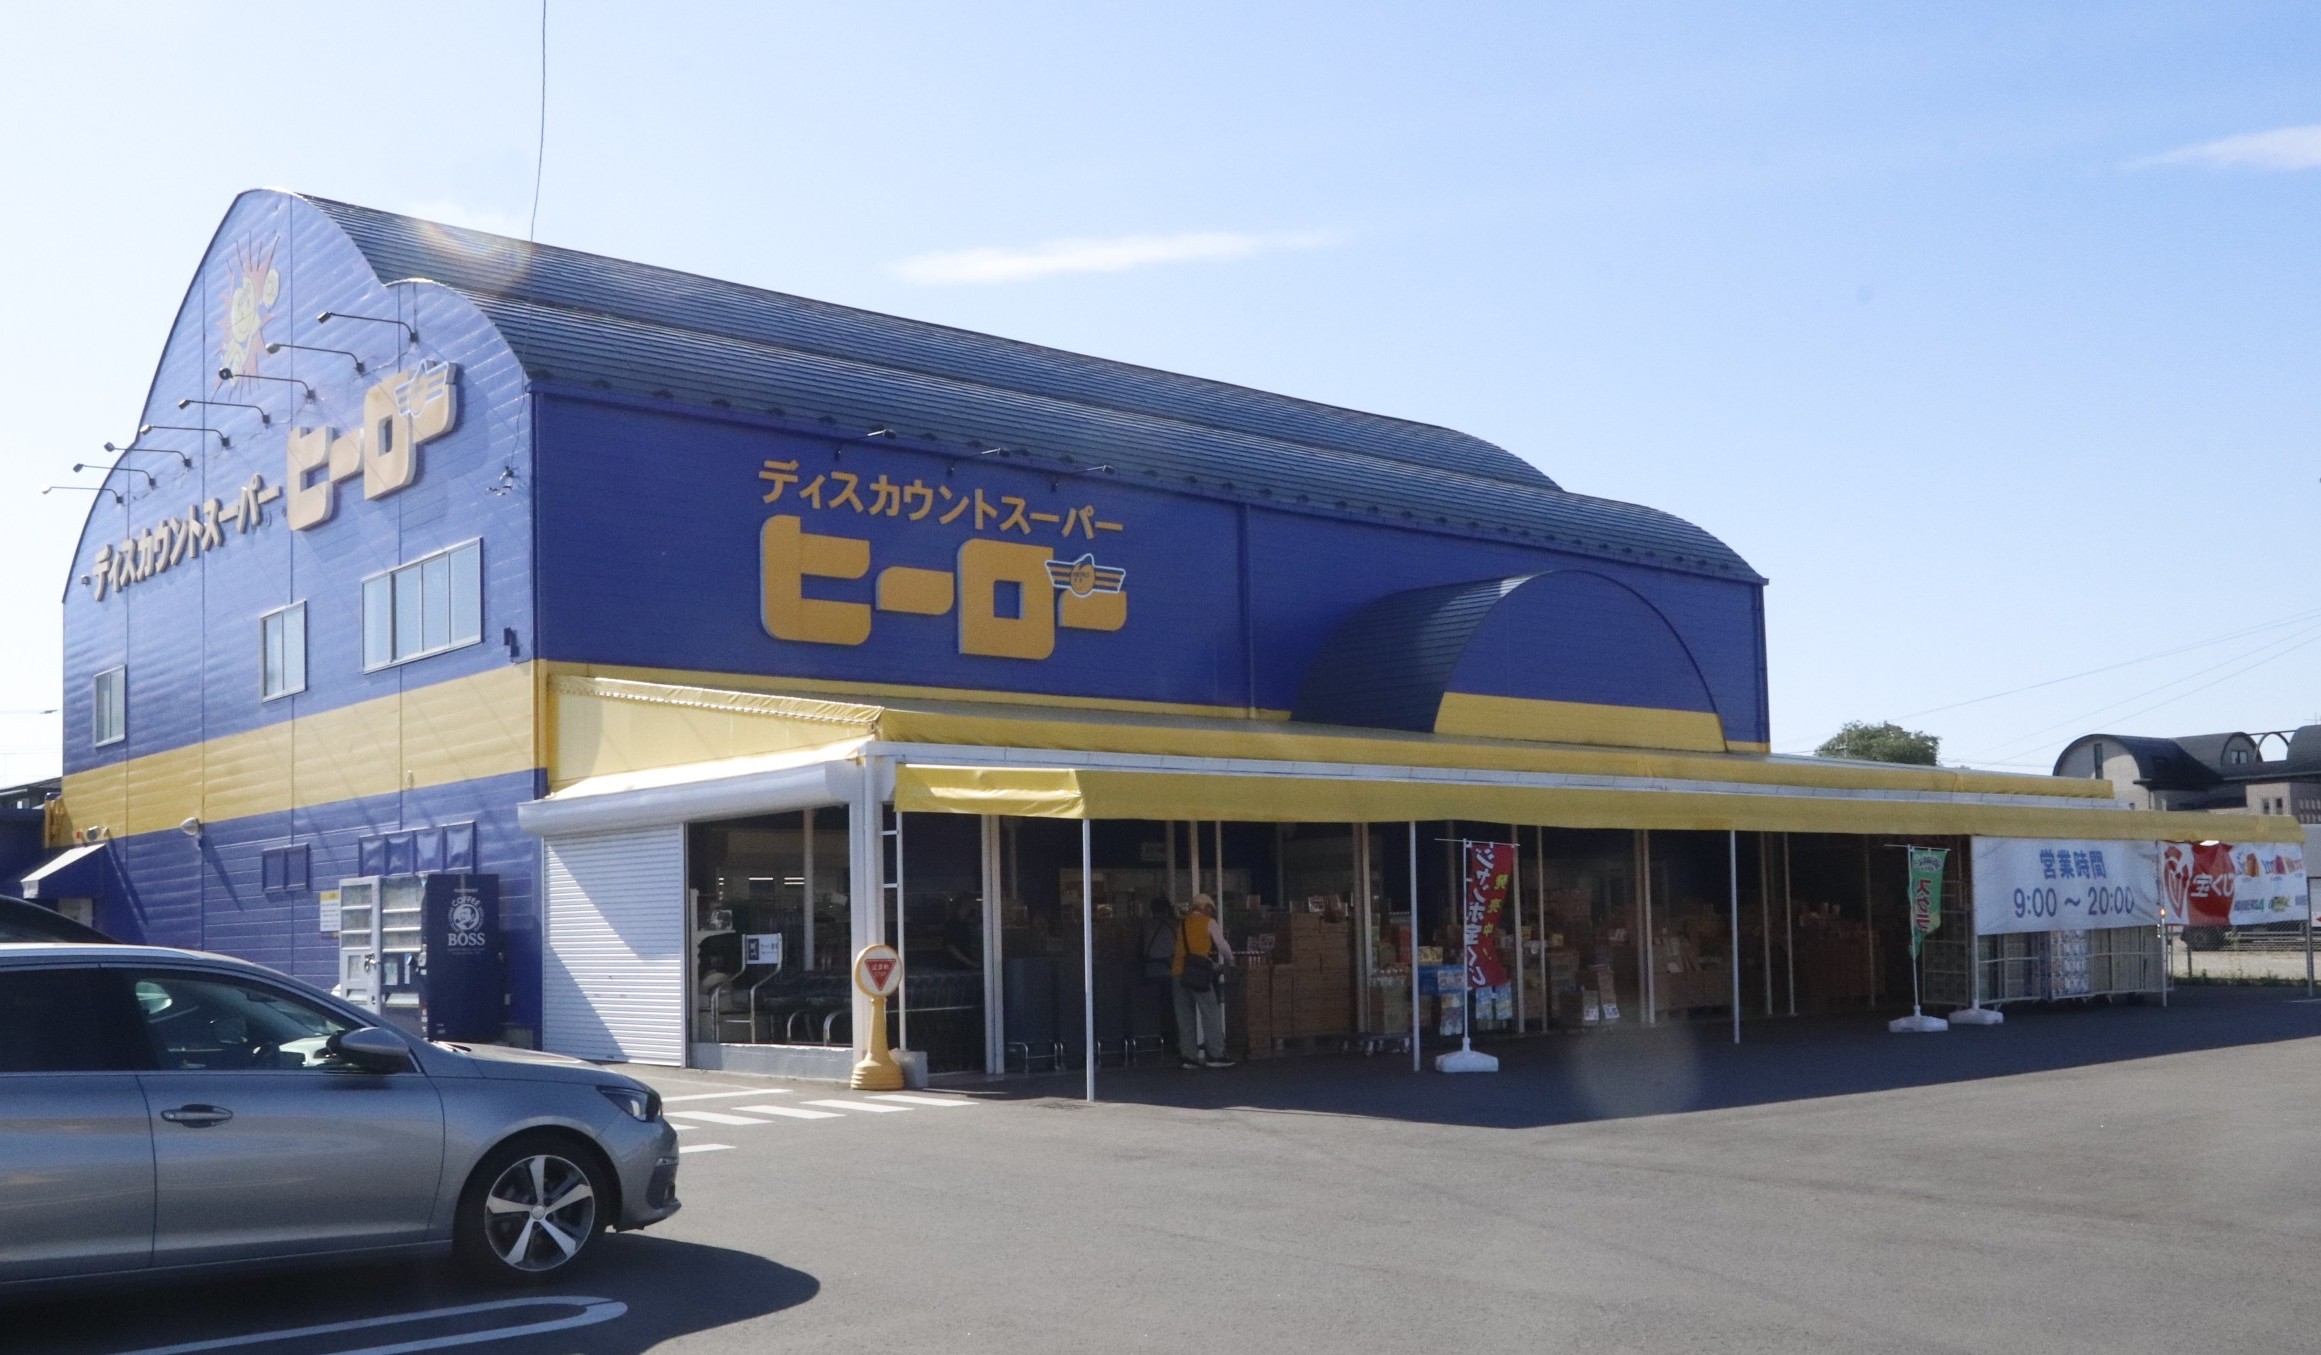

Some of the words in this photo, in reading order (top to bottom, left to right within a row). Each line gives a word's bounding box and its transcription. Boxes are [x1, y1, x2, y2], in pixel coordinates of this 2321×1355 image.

[287, 367, 457, 531] ヒーロー
[759, 459, 1124, 539] ディスカウントスーパー
[93, 473, 281, 601] ディスカウントスーパー
[760, 514, 1127, 660] ヒーロー
[2040, 849, 2107, 880] 営業時間
[2190, 873, 2235, 898] 宝くじ
[452, 896, 481, 907] COFFEE
[448, 933, 486, 946] BOSS
